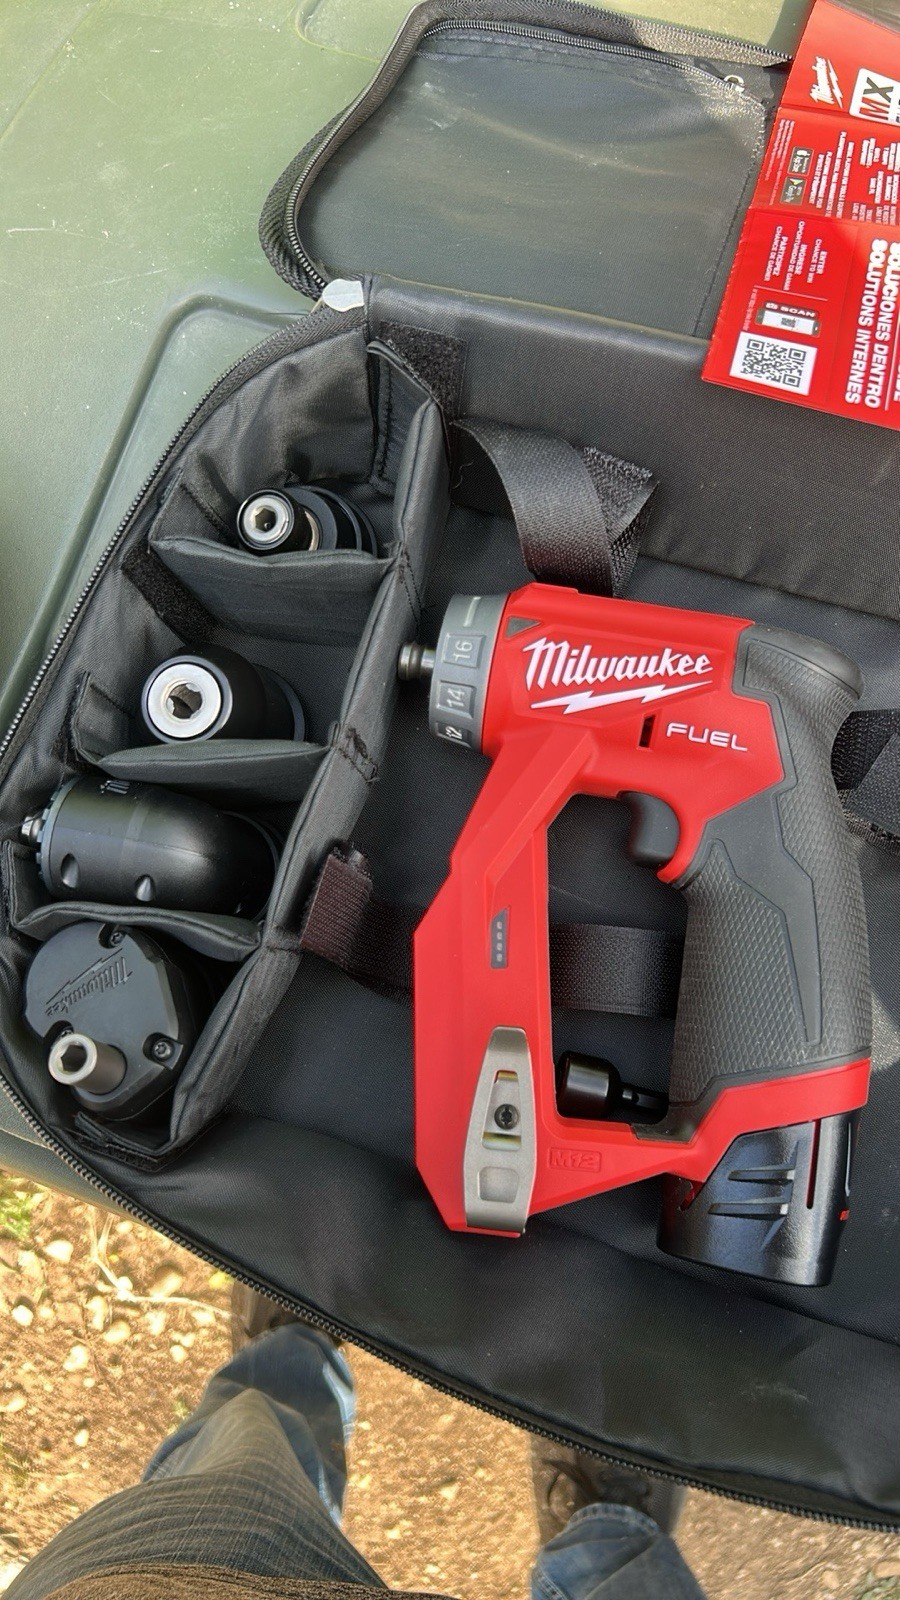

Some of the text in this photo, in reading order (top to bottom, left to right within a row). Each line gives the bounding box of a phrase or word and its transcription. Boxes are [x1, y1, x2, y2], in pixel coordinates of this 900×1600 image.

[859, 76, 894, 121] MX
[772, 226, 782, 251] CHANCE
[790, 221, 805, 265] OPORTUNIDAD
[770, 252, 776, 260] DE
[773, 236, 788, 277] PARTICIPEZ
[795, 244, 808, 276] INGRESE
[812, 239, 822, 264] CHANCE
[817, 251, 827, 275] ENTER
[788, 265, 794, 273] DE
[810, 264, 816, 272] TO
[780, 306, 815, 317] SCAN
[845, 239, 888, 404] SOLUTIONS INTERNES
[864, 241, 900, 409] SOLUCIONES DENTRO
[453, 640, 472, 661] 16
[523, 636, 713, 691] Milwaukee
[447, 687, 466, 708] 14
[667, 722, 748, 751] FUEL
[46, 956, 133, 1016] Milwaukee
[553, 1150, 600, 1168] M12
